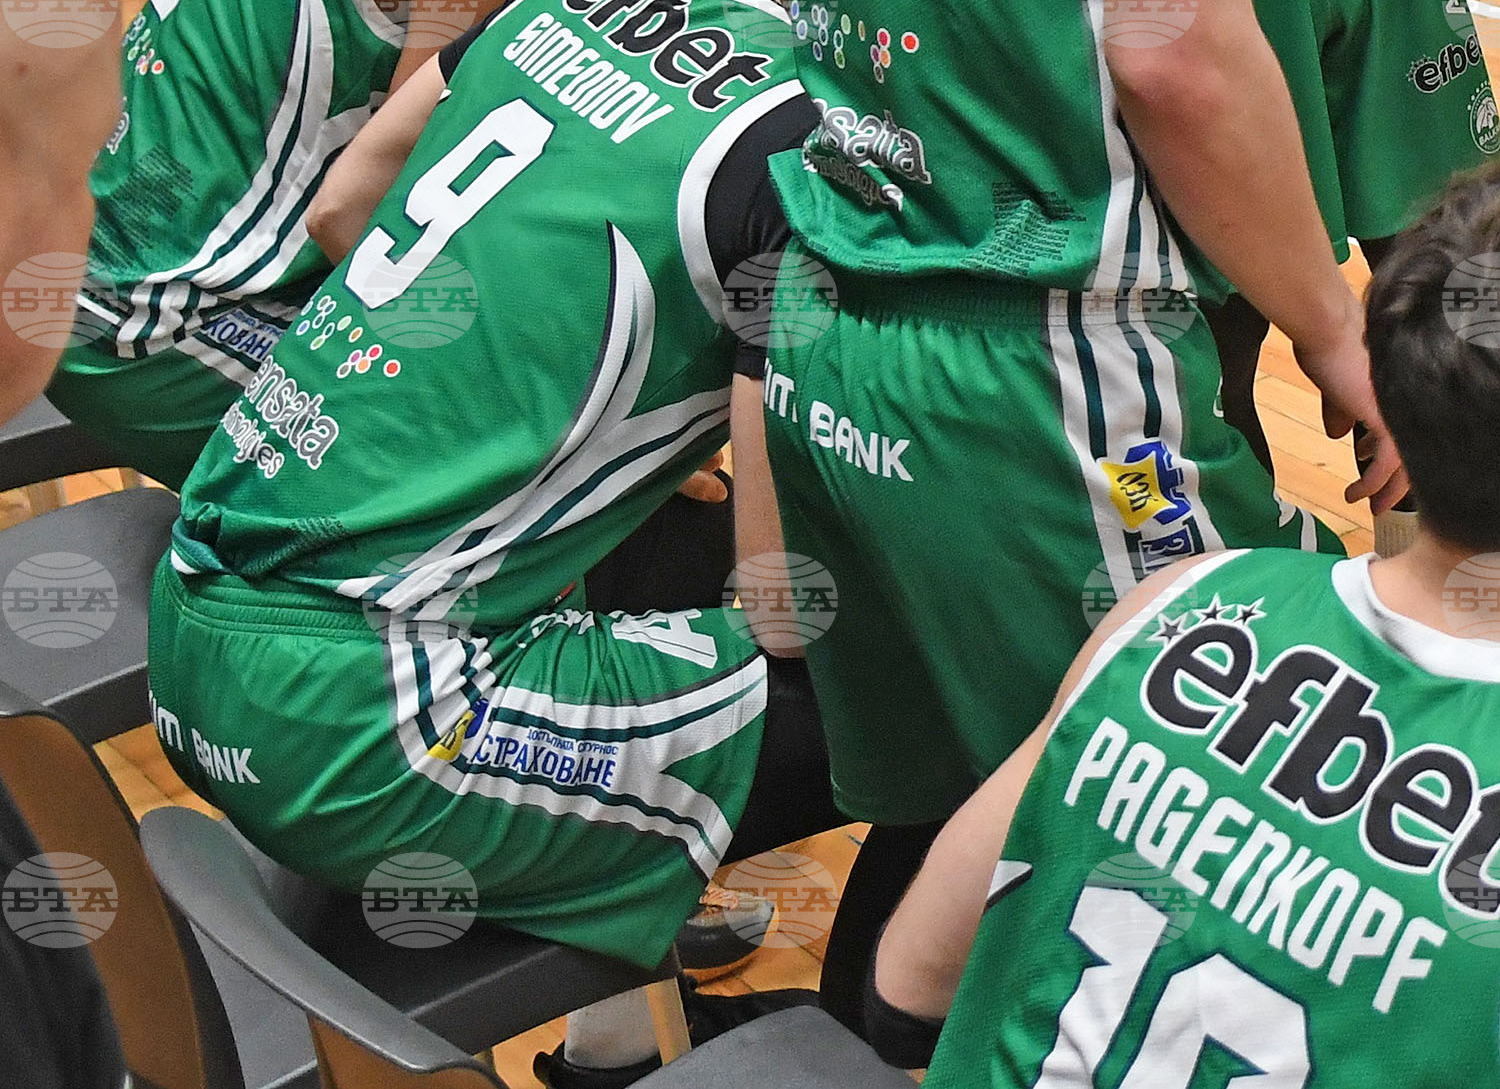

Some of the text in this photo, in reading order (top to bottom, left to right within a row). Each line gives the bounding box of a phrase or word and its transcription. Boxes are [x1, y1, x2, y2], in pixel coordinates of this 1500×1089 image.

[503, 12, 676, 145] SIMEONOV
[1413, 33, 1483, 95] efbe
[344, 97, 557, 311] 9
[808, 399, 915, 483] BANK
[1062, 716, 1449, 1016] PAGENKOPF
